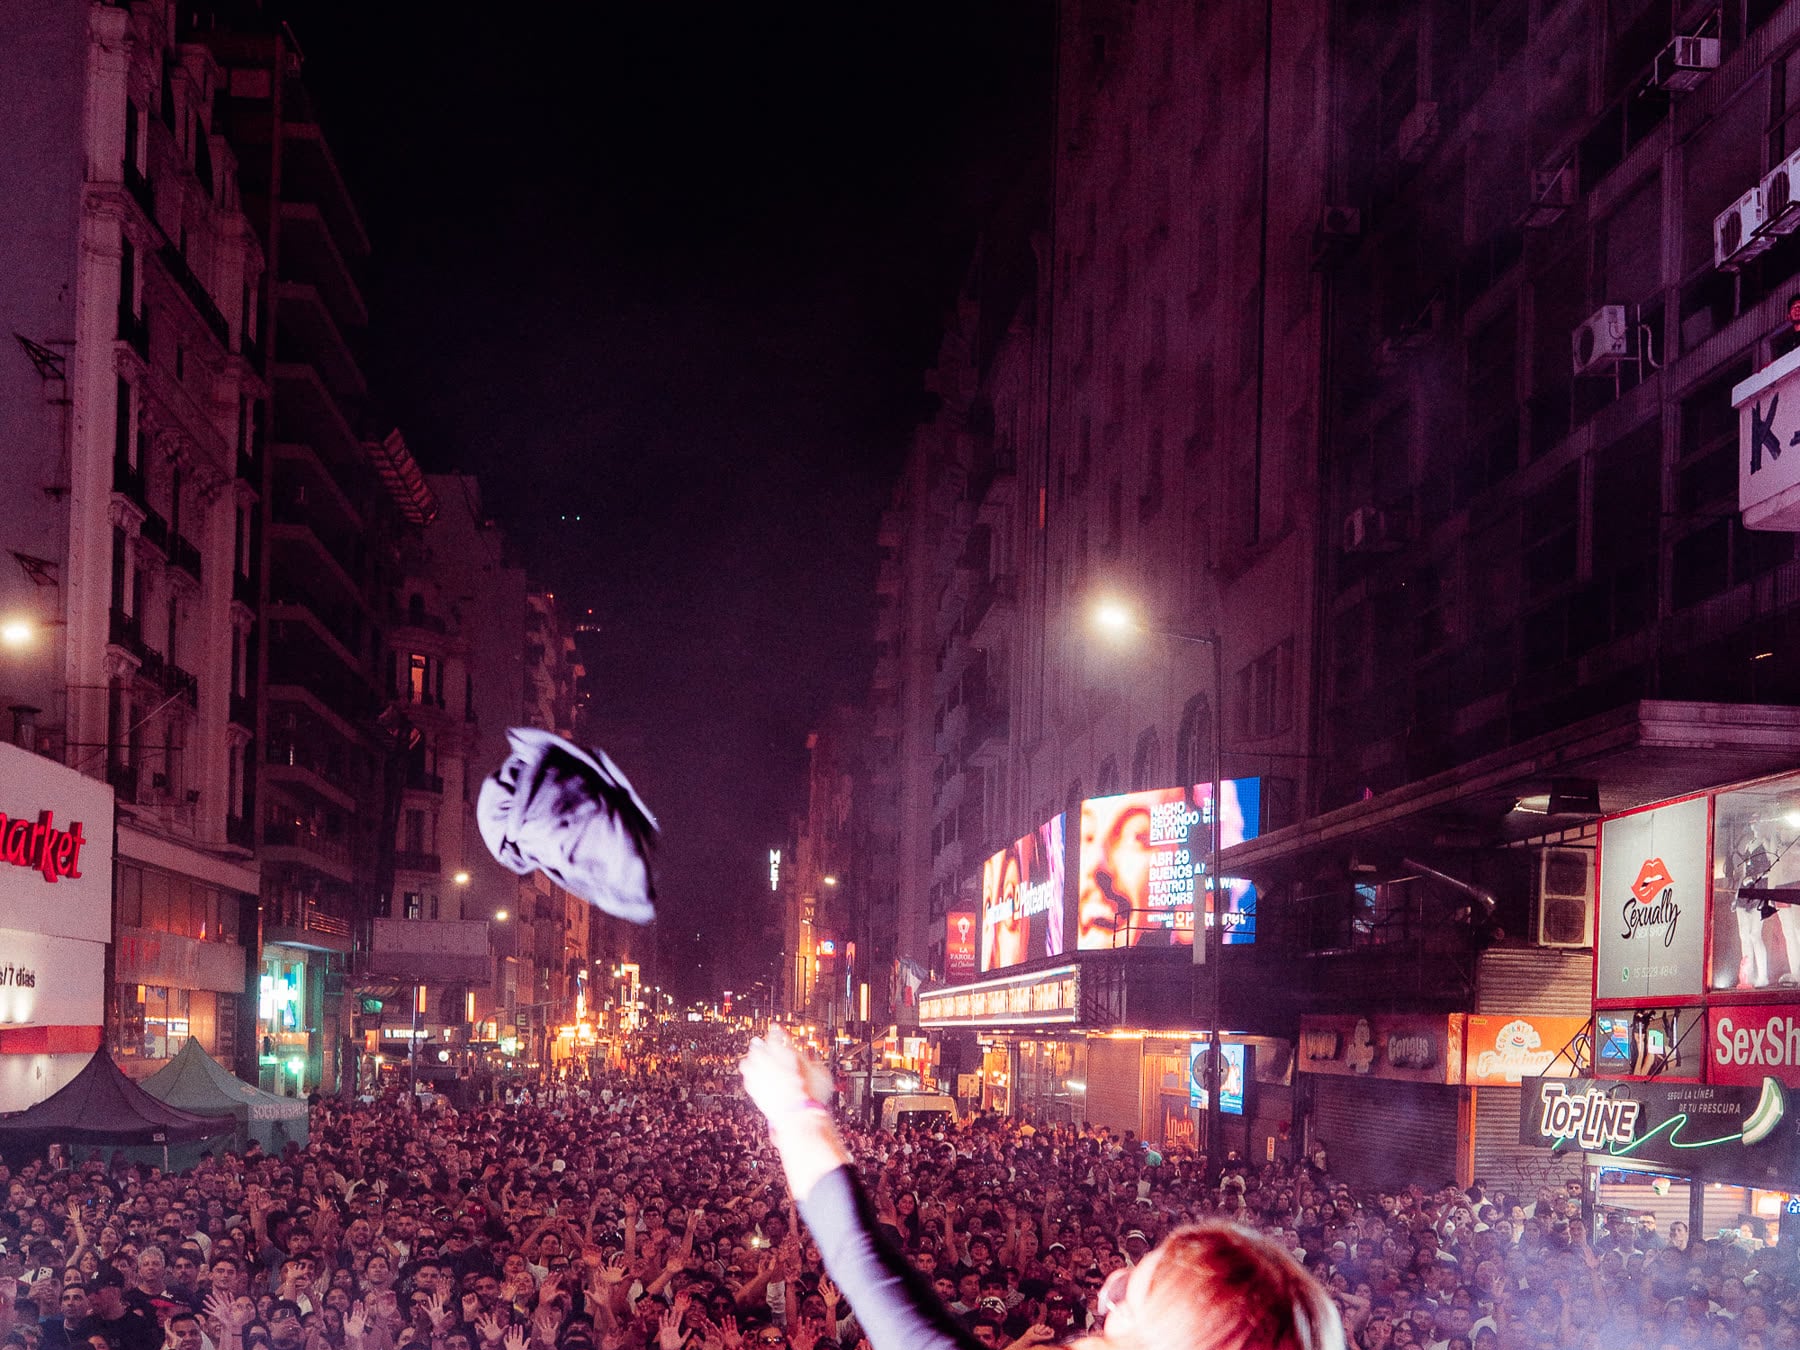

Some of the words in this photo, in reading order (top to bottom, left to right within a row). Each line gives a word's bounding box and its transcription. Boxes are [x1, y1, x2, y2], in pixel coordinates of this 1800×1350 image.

[1151, 801, 1186, 816] NACHO
[1150, 811, 1200, 829] REDONDO
[1150, 828, 1163, 841] EN
[1164, 825, 1188, 839] VIVO
[1149, 851, 1173, 867] ABR
[1174, 850, 1190, 865] 29
[1149, 865, 1193, 881] BUENOS
[1148, 880, 1186, 895] TEATRO
[1621, 888, 1682, 948] Sexually
[16, 968, 36, 989] días
[1667, 1090, 1683, 1101] SEGUÍ
[1684, 1090, 1693, 1100] LA
[1693, 1088, 1714, 1099] LÍNEA
[1678, 1102, 1688, 1112] DE
[1688, 1103, 1698, 1113] TU
[1698, 1103, 1741, 1114] FRESCURA
